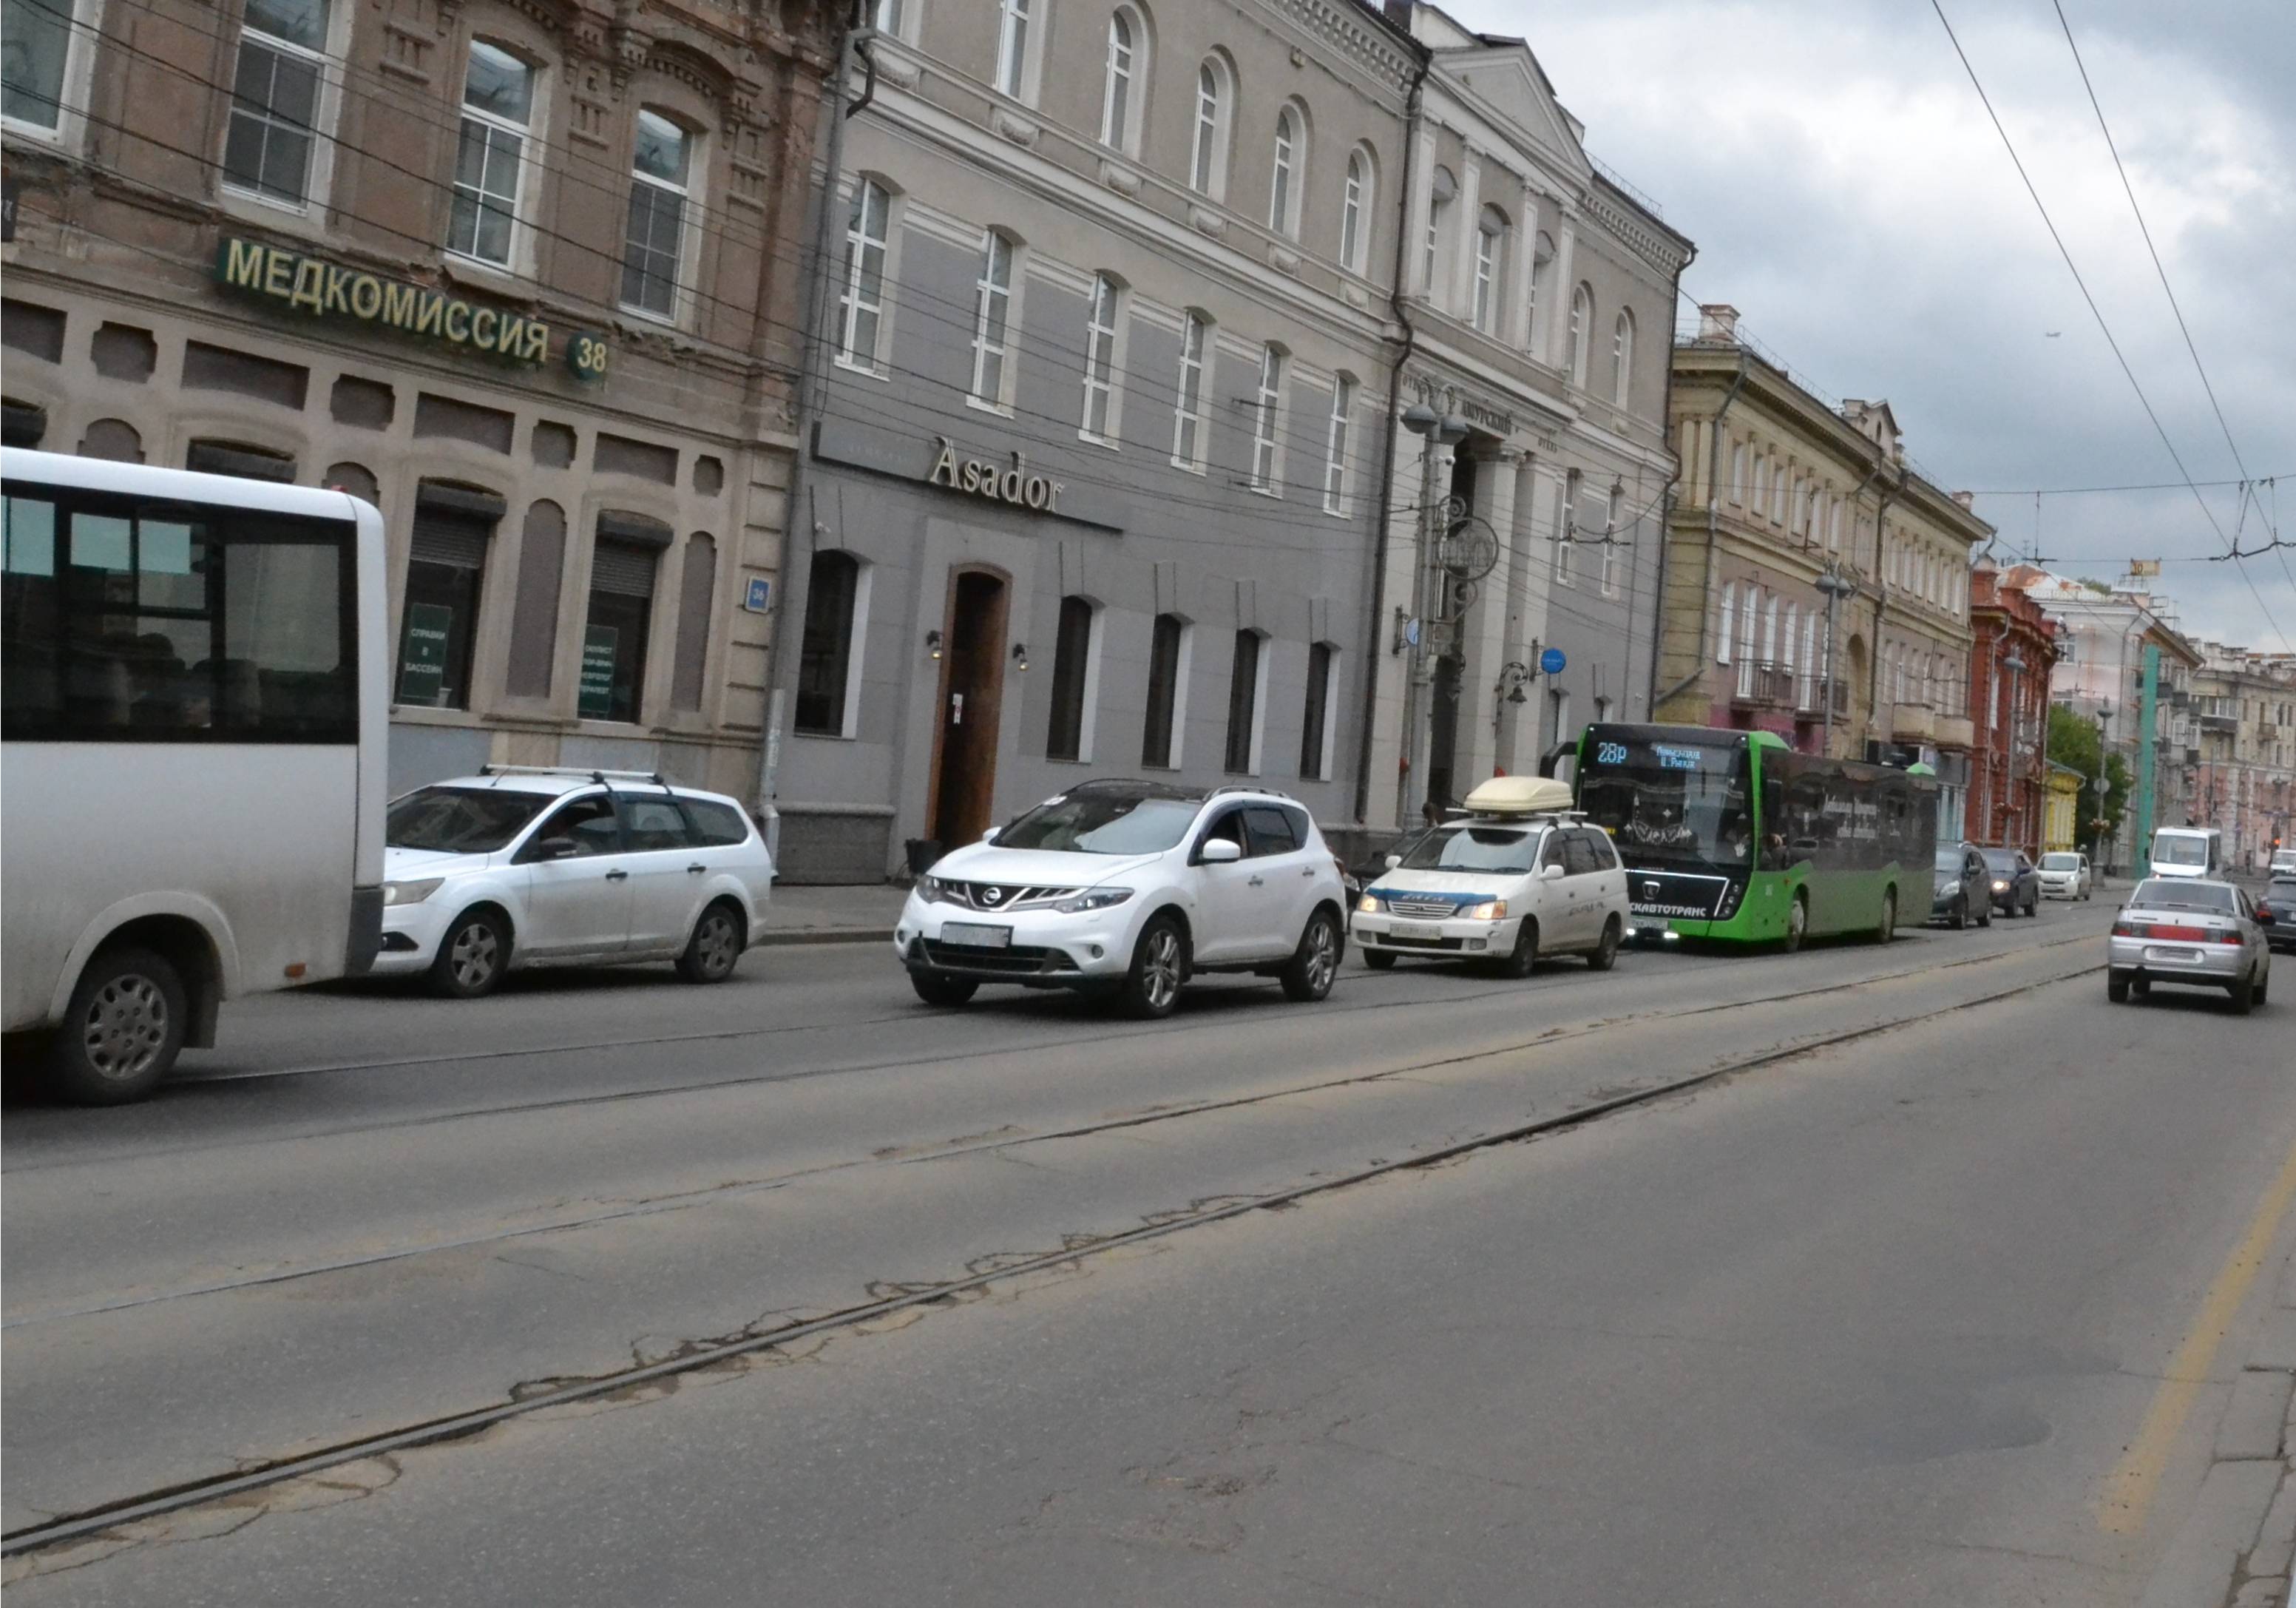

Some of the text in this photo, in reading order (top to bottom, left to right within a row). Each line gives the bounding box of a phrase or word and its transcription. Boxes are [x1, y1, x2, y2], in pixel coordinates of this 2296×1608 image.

[225, 238, 549, 362] МЕДКОМИССИЯ
[577, 337, 607, 372] 38
[929, 435, 1065, 512] Asador
[410, 628, 446, 640] СПРАВКИ
[405, 662, 443, 674] БАССЕЙН
